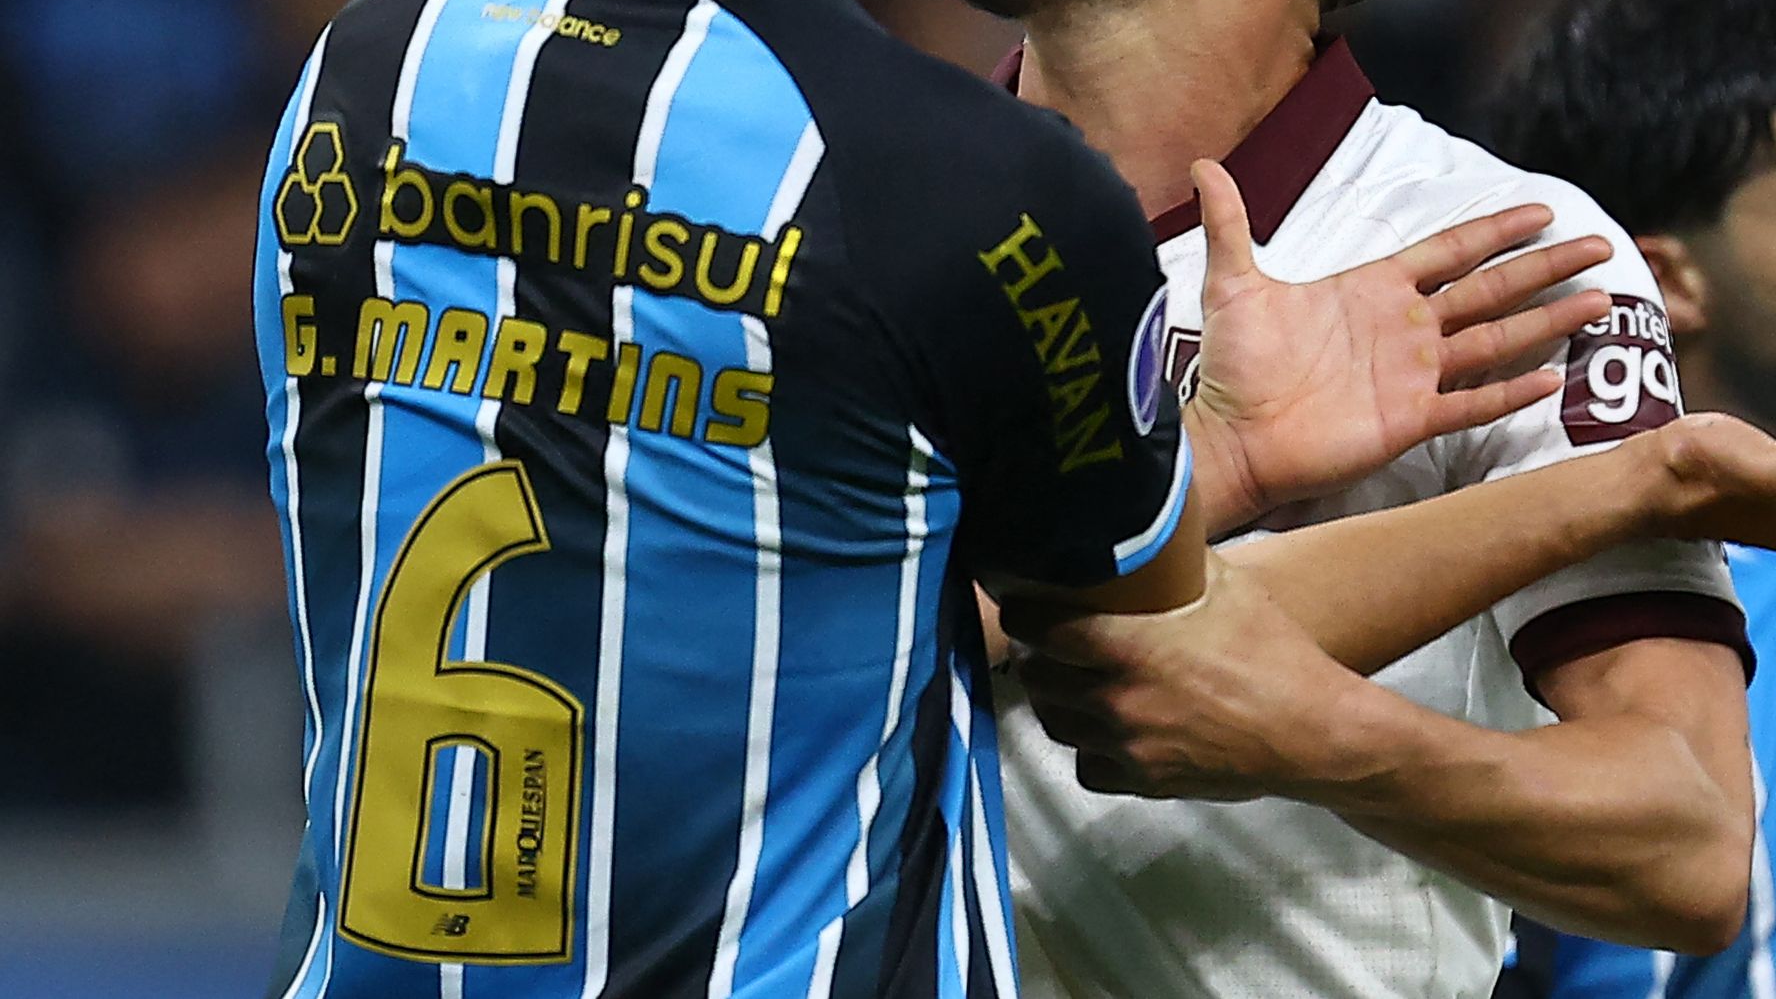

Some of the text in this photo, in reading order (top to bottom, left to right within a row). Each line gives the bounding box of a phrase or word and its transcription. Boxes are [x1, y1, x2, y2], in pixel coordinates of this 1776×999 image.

[379, 144, 801, 317] banrisul
[281, 294, 775, 448] G. MARTINS
[977, 212, 1124, 473] HAVAN
[336, 458, 585, 966] 6
